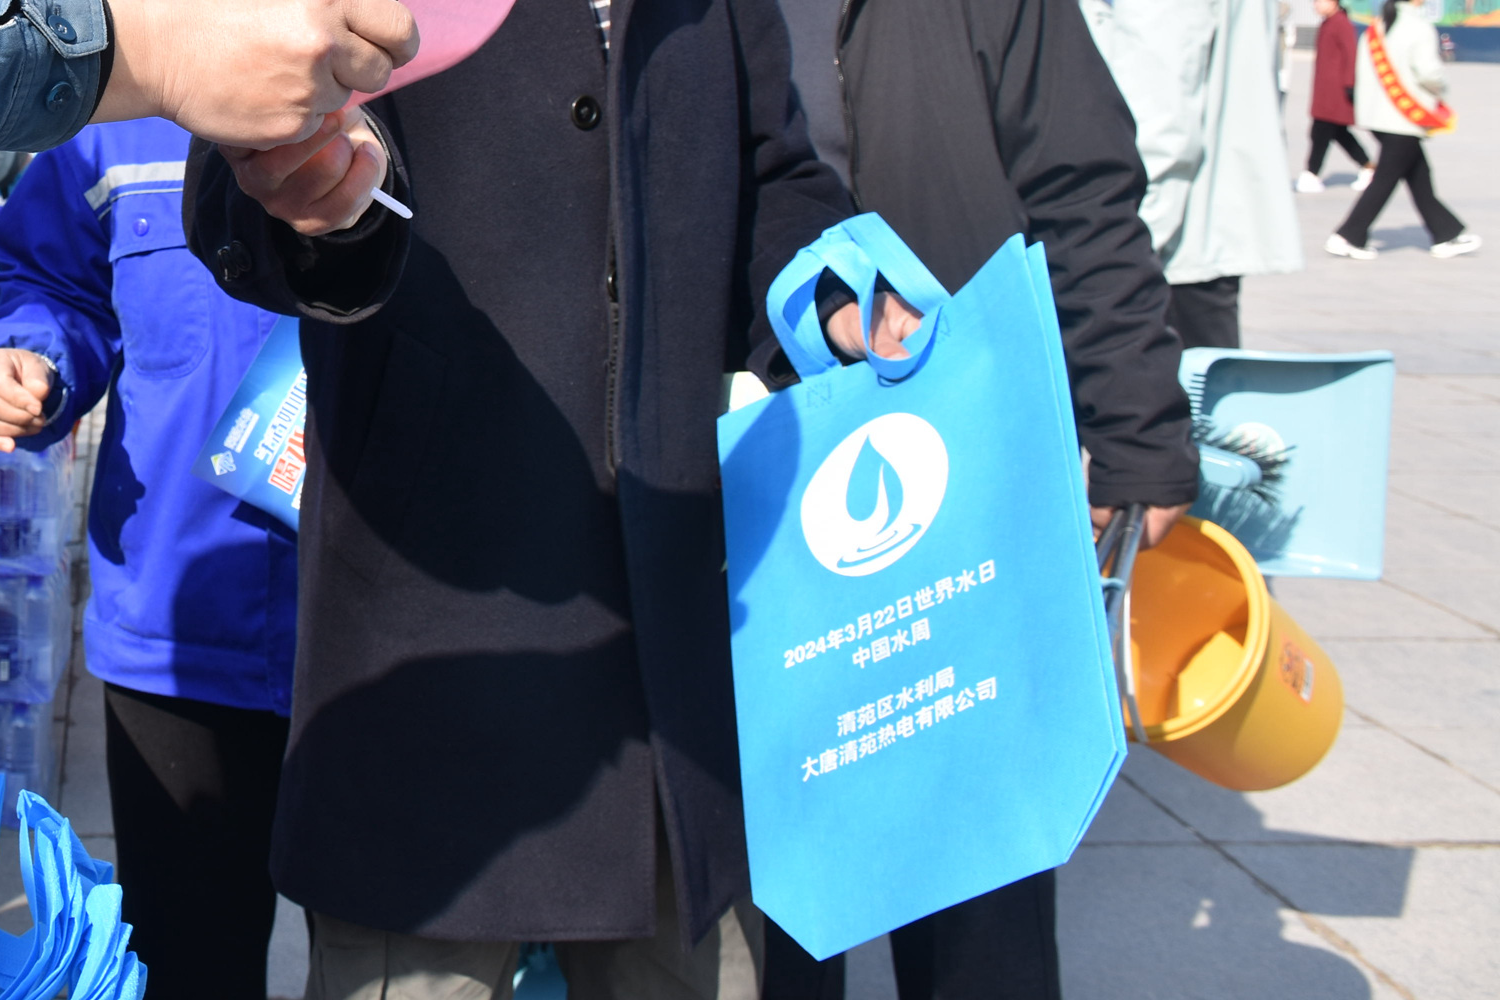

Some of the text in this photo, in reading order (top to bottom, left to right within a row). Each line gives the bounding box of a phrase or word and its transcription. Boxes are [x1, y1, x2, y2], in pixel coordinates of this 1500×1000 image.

[783, 558, 997, 669] 2024年3月22日世界水日
[851, 617, 932, 670] 中国水周
[800, 676, 998, 783] 大唐清苑热电有限公司
[836, 665, 956, 738] 清苑区水利局
